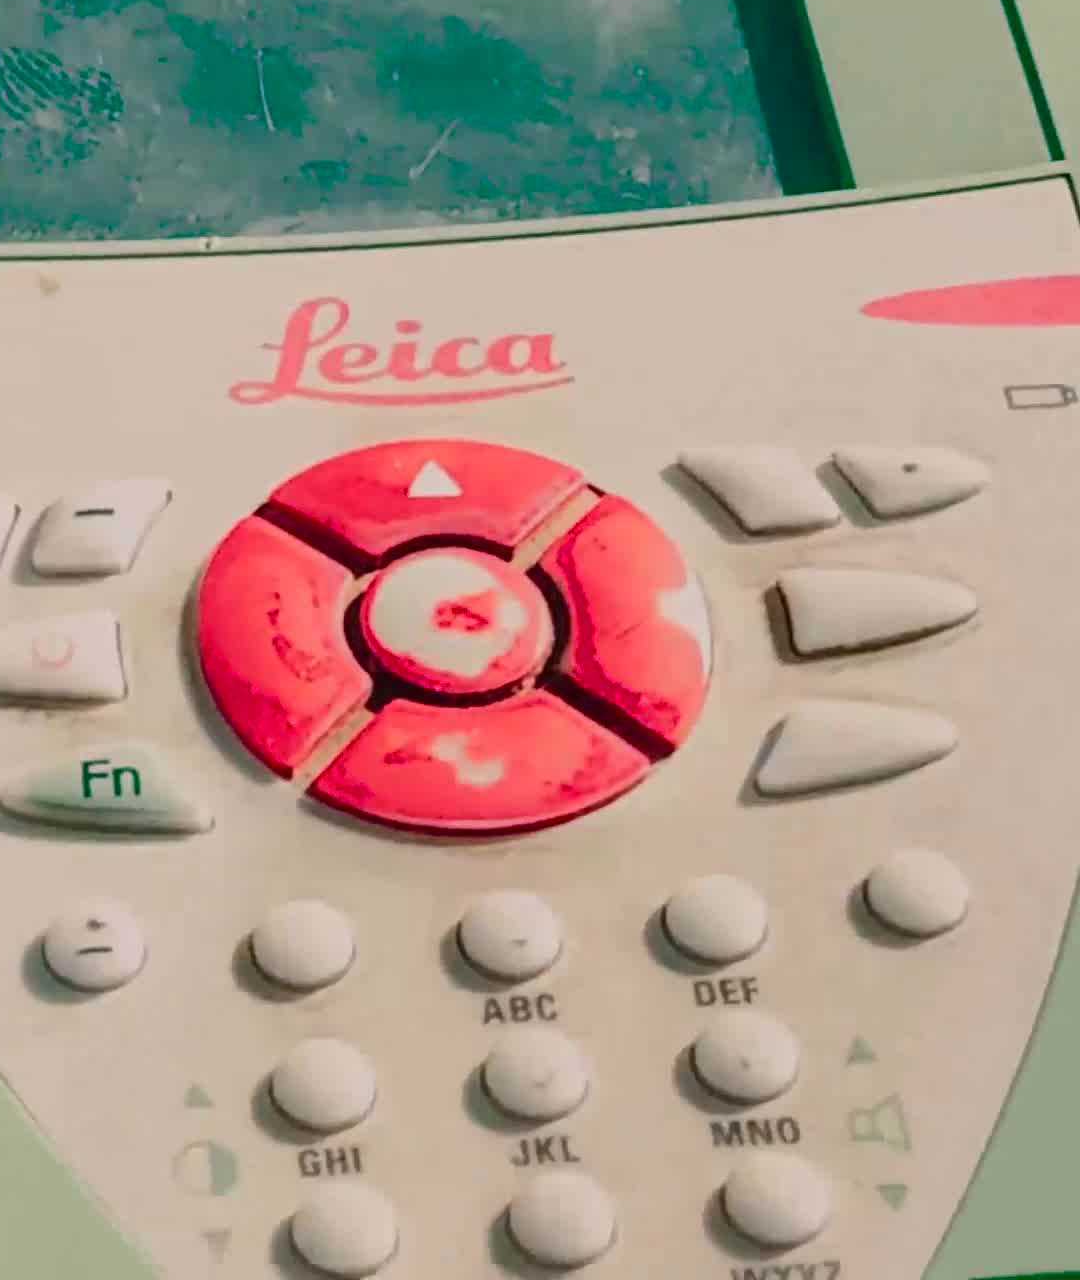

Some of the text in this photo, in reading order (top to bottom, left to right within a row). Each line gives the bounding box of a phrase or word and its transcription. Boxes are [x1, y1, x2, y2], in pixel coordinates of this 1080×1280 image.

[228, 296, 575, 406] Leica
[82, 759, 141, 798] Fn
[693, 977, 758, 1007] DEF
[483, 993, 558, 1025] ABC
[710, 1117, 800, 1147] MNO
[298, 1146, 363, 1178] GHI
[510, 1136, 581, 1167] JKL
